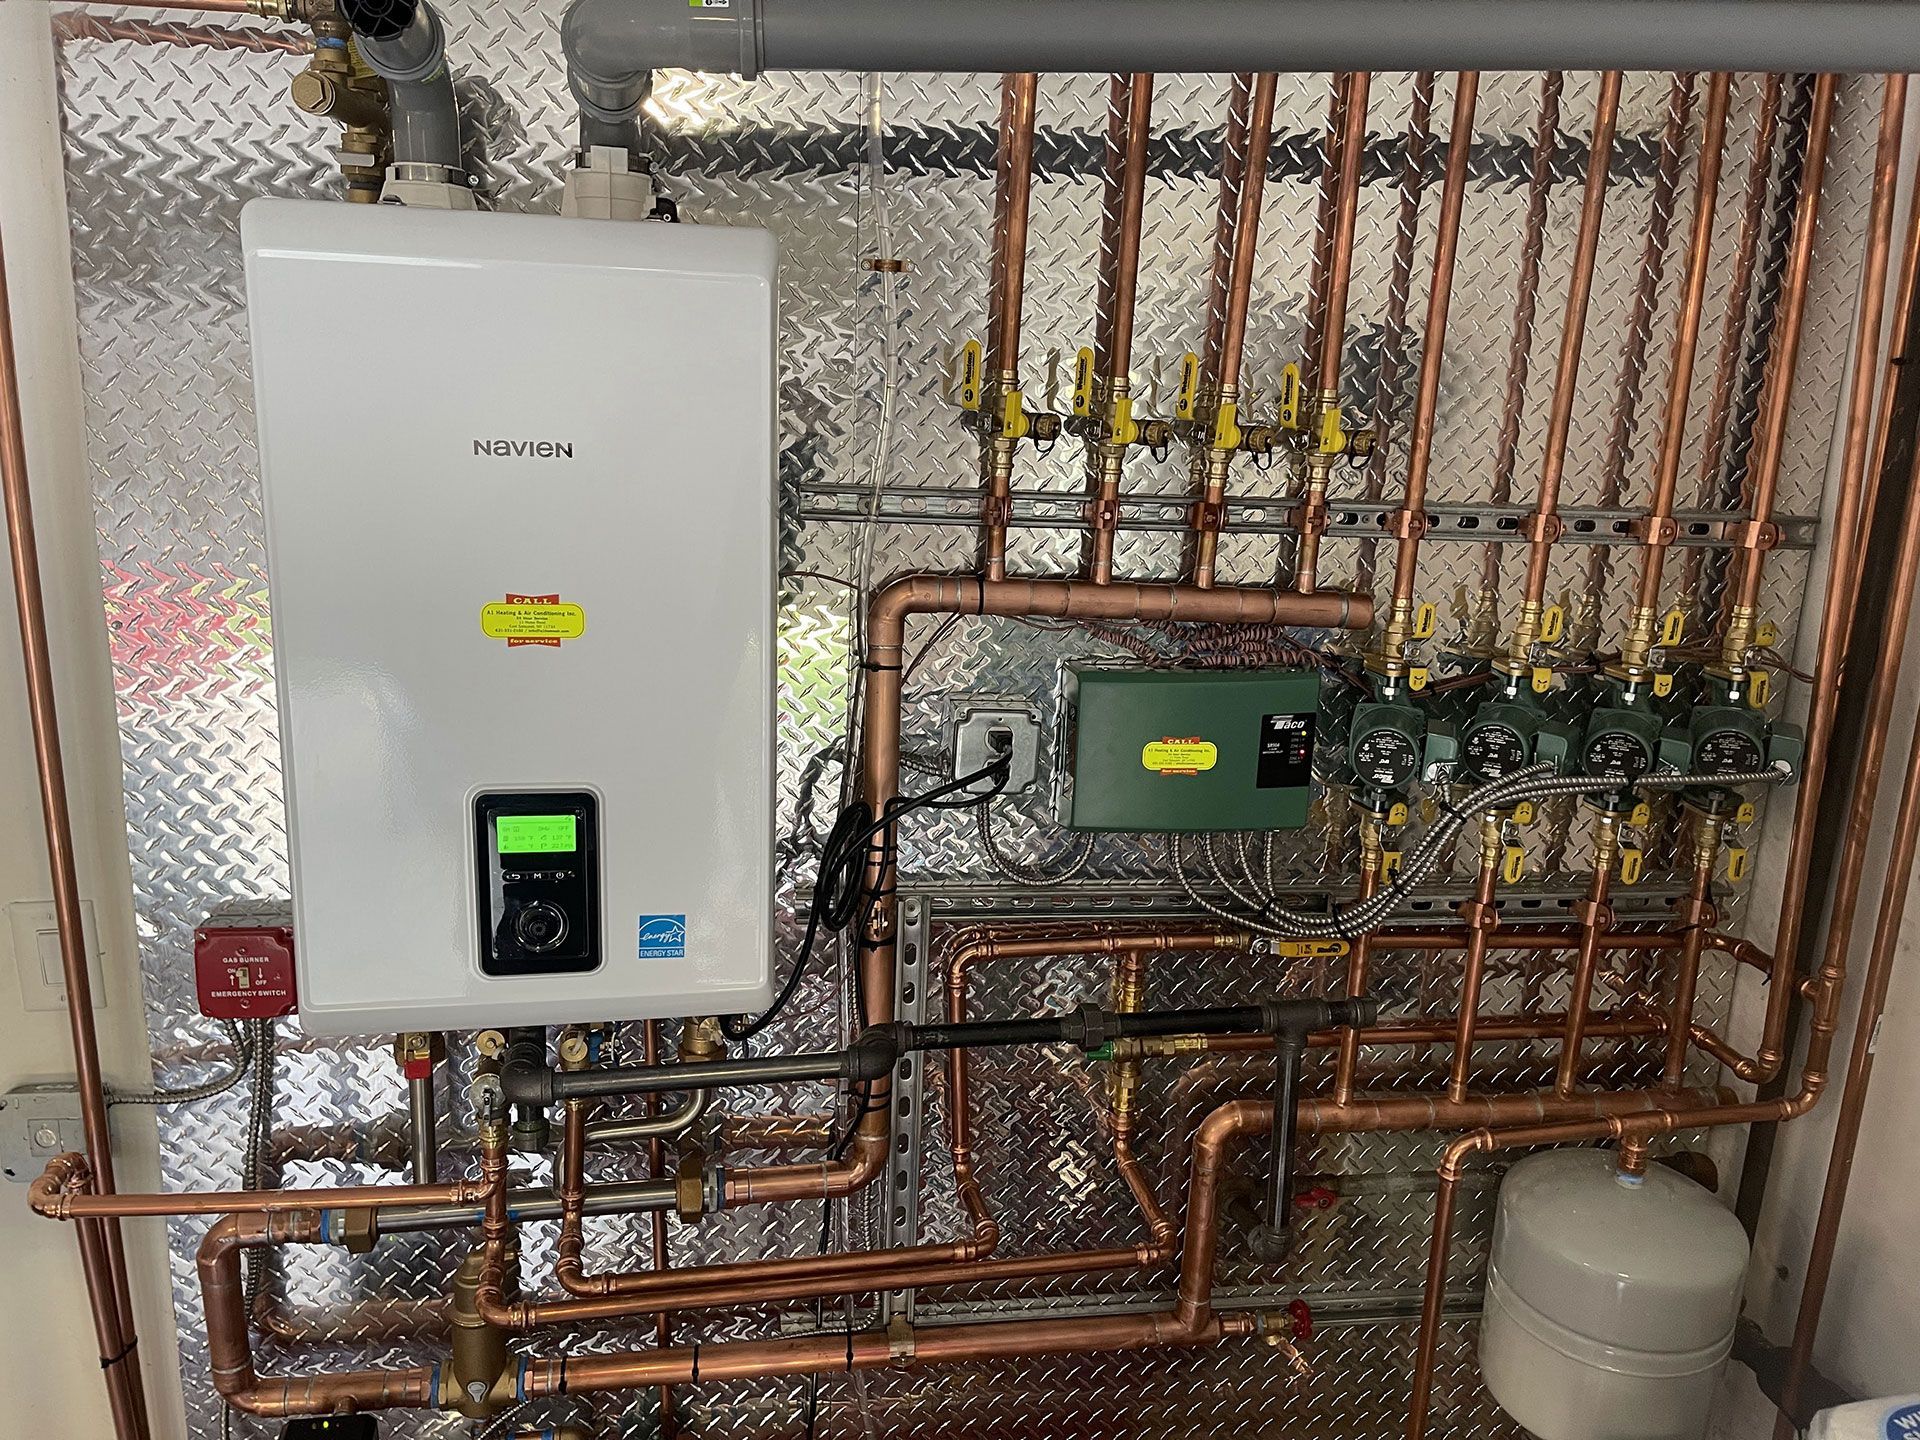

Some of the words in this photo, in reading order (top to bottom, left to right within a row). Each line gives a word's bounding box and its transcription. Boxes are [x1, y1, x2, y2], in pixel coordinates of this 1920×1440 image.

[496, 610, 516, 618] Heating
[1271, 715, 1305, 730] Taco
[640, 949, 666, 957] ENERGY
